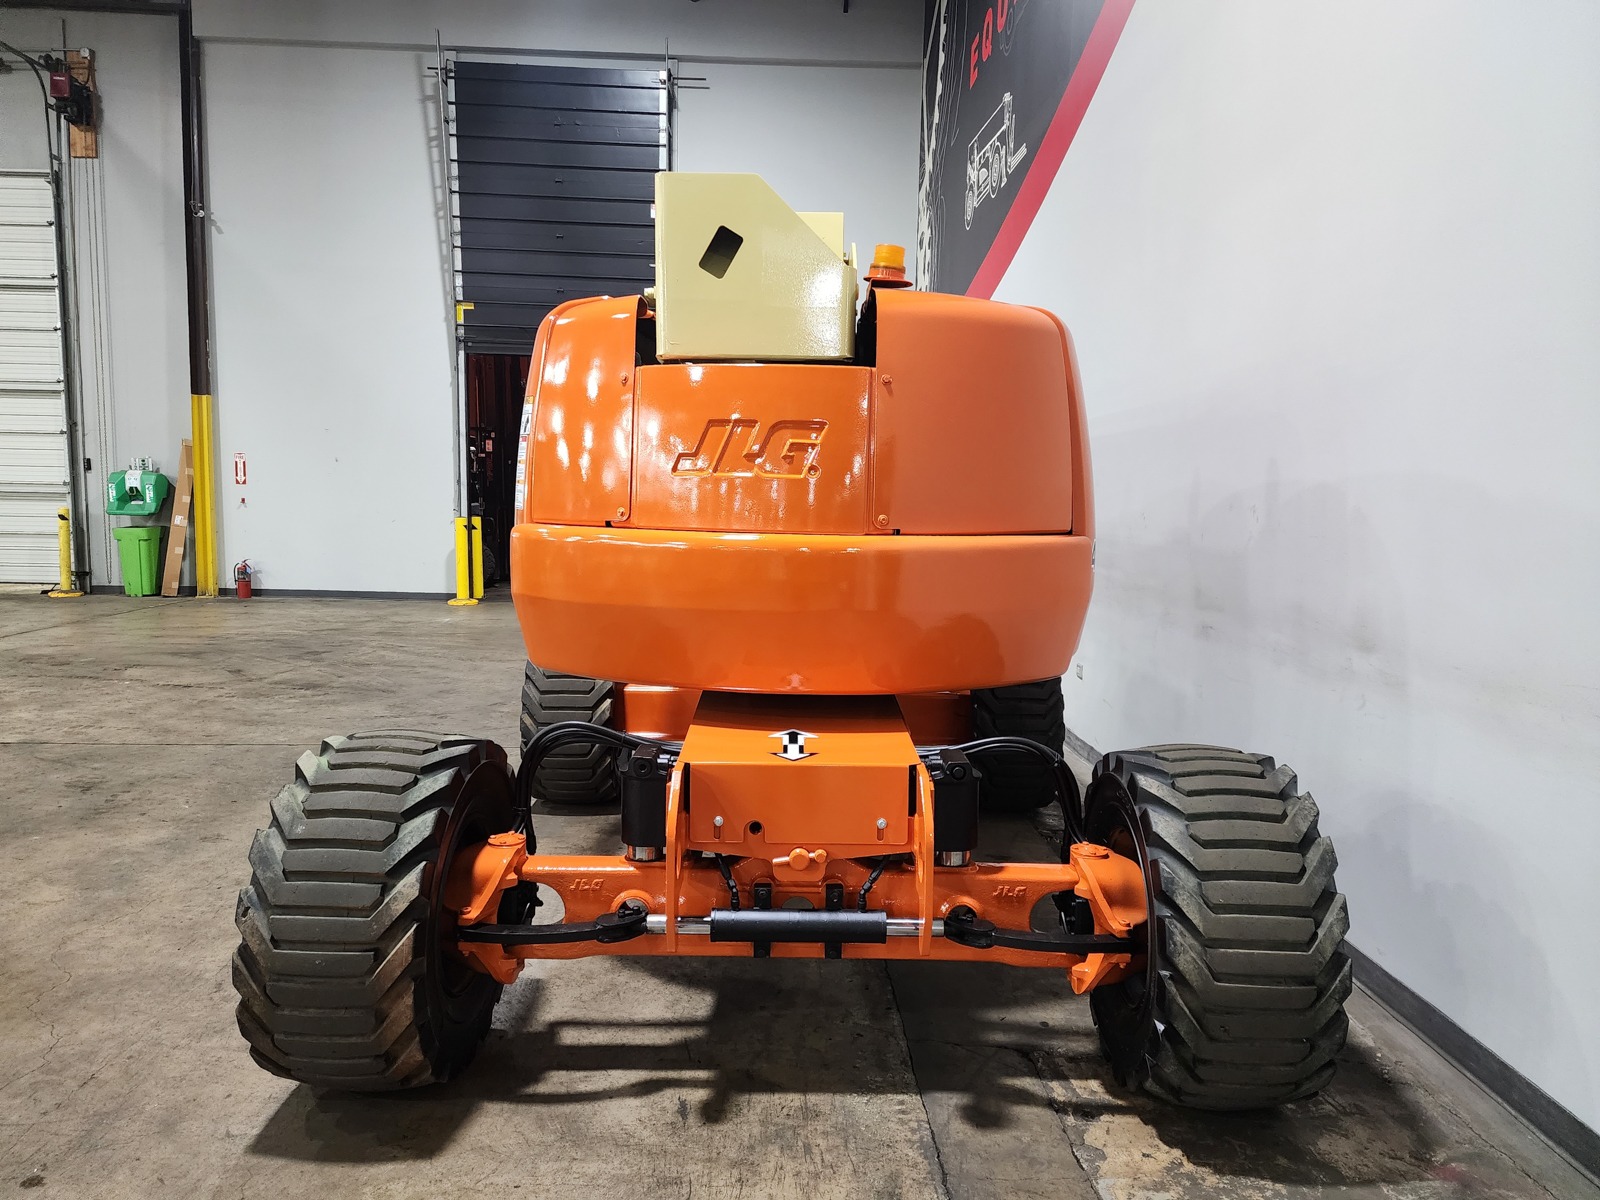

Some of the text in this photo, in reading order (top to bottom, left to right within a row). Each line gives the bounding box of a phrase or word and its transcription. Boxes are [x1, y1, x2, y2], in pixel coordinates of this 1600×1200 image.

[969, 0, 1017, 90] EQU
[671, 418, 829, 479] JLG
[569, 878, 605, 891] JLG
